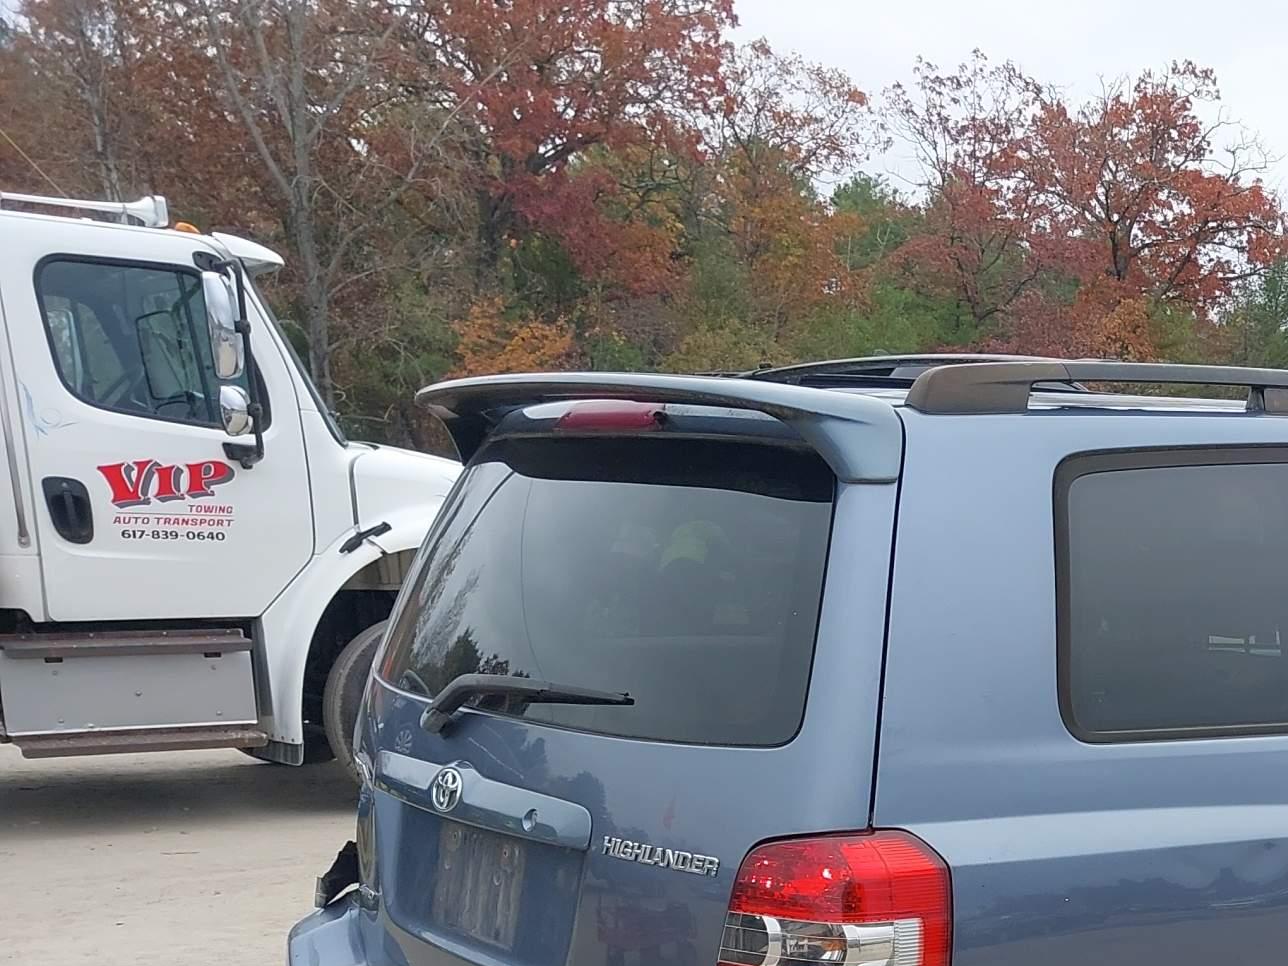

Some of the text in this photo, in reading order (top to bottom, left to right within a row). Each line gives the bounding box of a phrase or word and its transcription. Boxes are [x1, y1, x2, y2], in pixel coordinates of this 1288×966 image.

[97, 460, 236, 509] VIP
[188, 504, 233, 514] TOWING
[112, 516, 234, 527] AUTO TRANSPORT
[121, 529, 225, 541] 617-839-0640
[602, 836, 720, 878] HIGHLANDER
